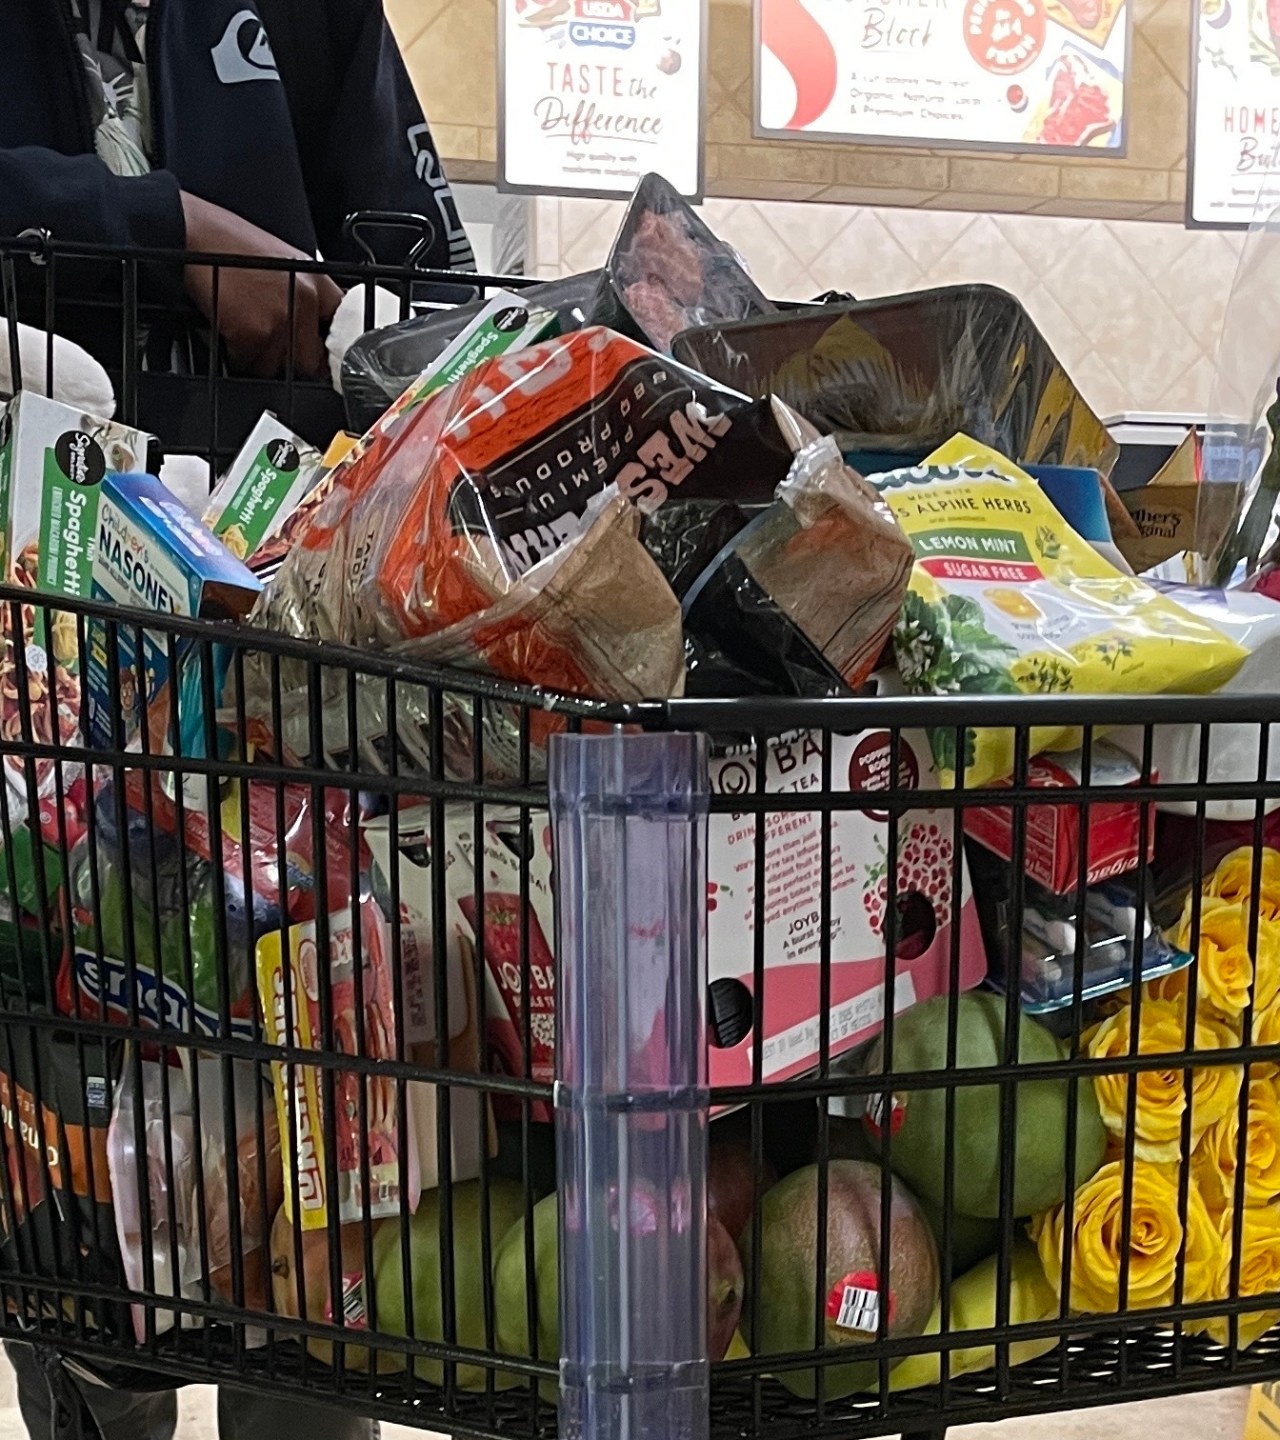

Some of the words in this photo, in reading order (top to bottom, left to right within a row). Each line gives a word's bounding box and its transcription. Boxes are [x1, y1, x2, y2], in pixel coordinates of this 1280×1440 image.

[572, 25, 633, 45] CHOICE
[546, 62, 624, 97] TASTE
[628, 78, 658, 99] the
[534, 96, 664, 145] Difference
[526, 424, 634, 514] PREMIU
[238, 467, 277, 528] Spaghetti
[917, 497, 979, 515] ALPINE
[984, 497, 1032, 515] HERBS
[63, 489, 87, 596] Spaghetti
[101, 503, 149, 563] Children's
[918, 536, 978, 551] LEMON
[980, 538, 1017, 555] MINT
[943, 562, 991, 579] SUGAR
[992, 564, 1027, 581] FREE
[727, 826, 757, 845] DRIN
[788, 911, 820, 935] JOYB
